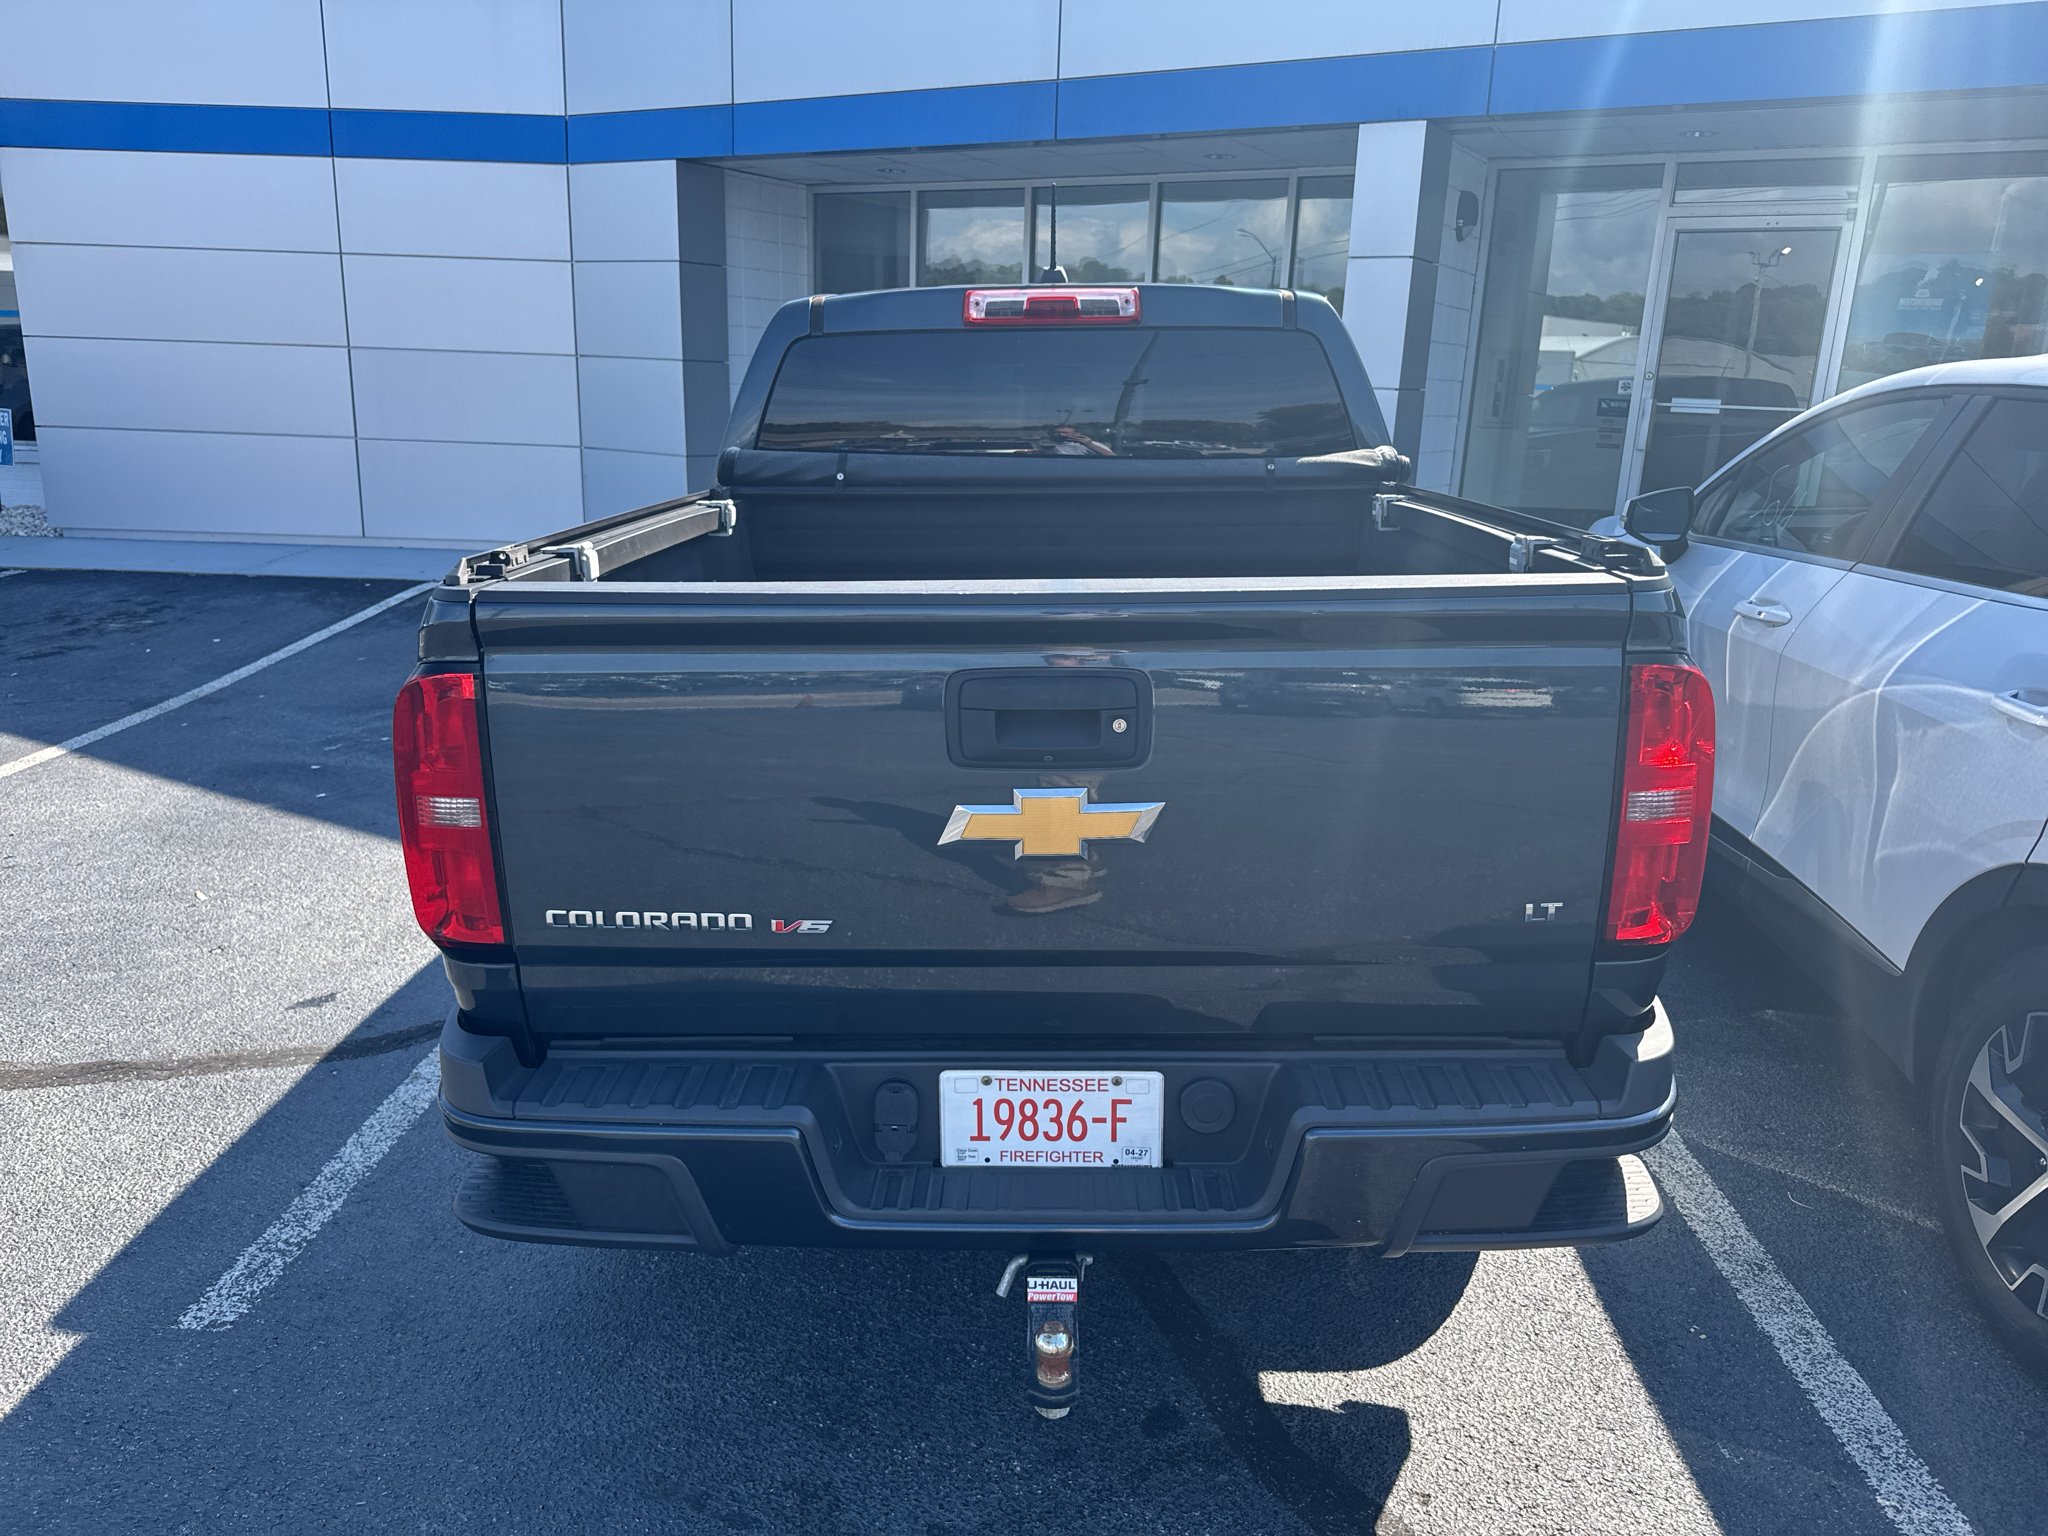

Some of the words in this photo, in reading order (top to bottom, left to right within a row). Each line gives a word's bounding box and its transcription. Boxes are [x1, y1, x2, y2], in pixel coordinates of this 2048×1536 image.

[1524, 902, 1564, 922] LT
[545, 908, 753, 932] COLORADO
[770, 918, 834, 934] V6
[994, 1077, 1109, 1093] TENNESSEE
[969, 1097, 1133, 1143] 19836-F
[1000, 1150, 1104, 1164] FIREFIGHTER
[1124, 1148, 1149, 1157] 04-27
[1027, 1280, 1076, 1290] U-HAUL
[1027, 1291, 1075, 1301] PowerTow
